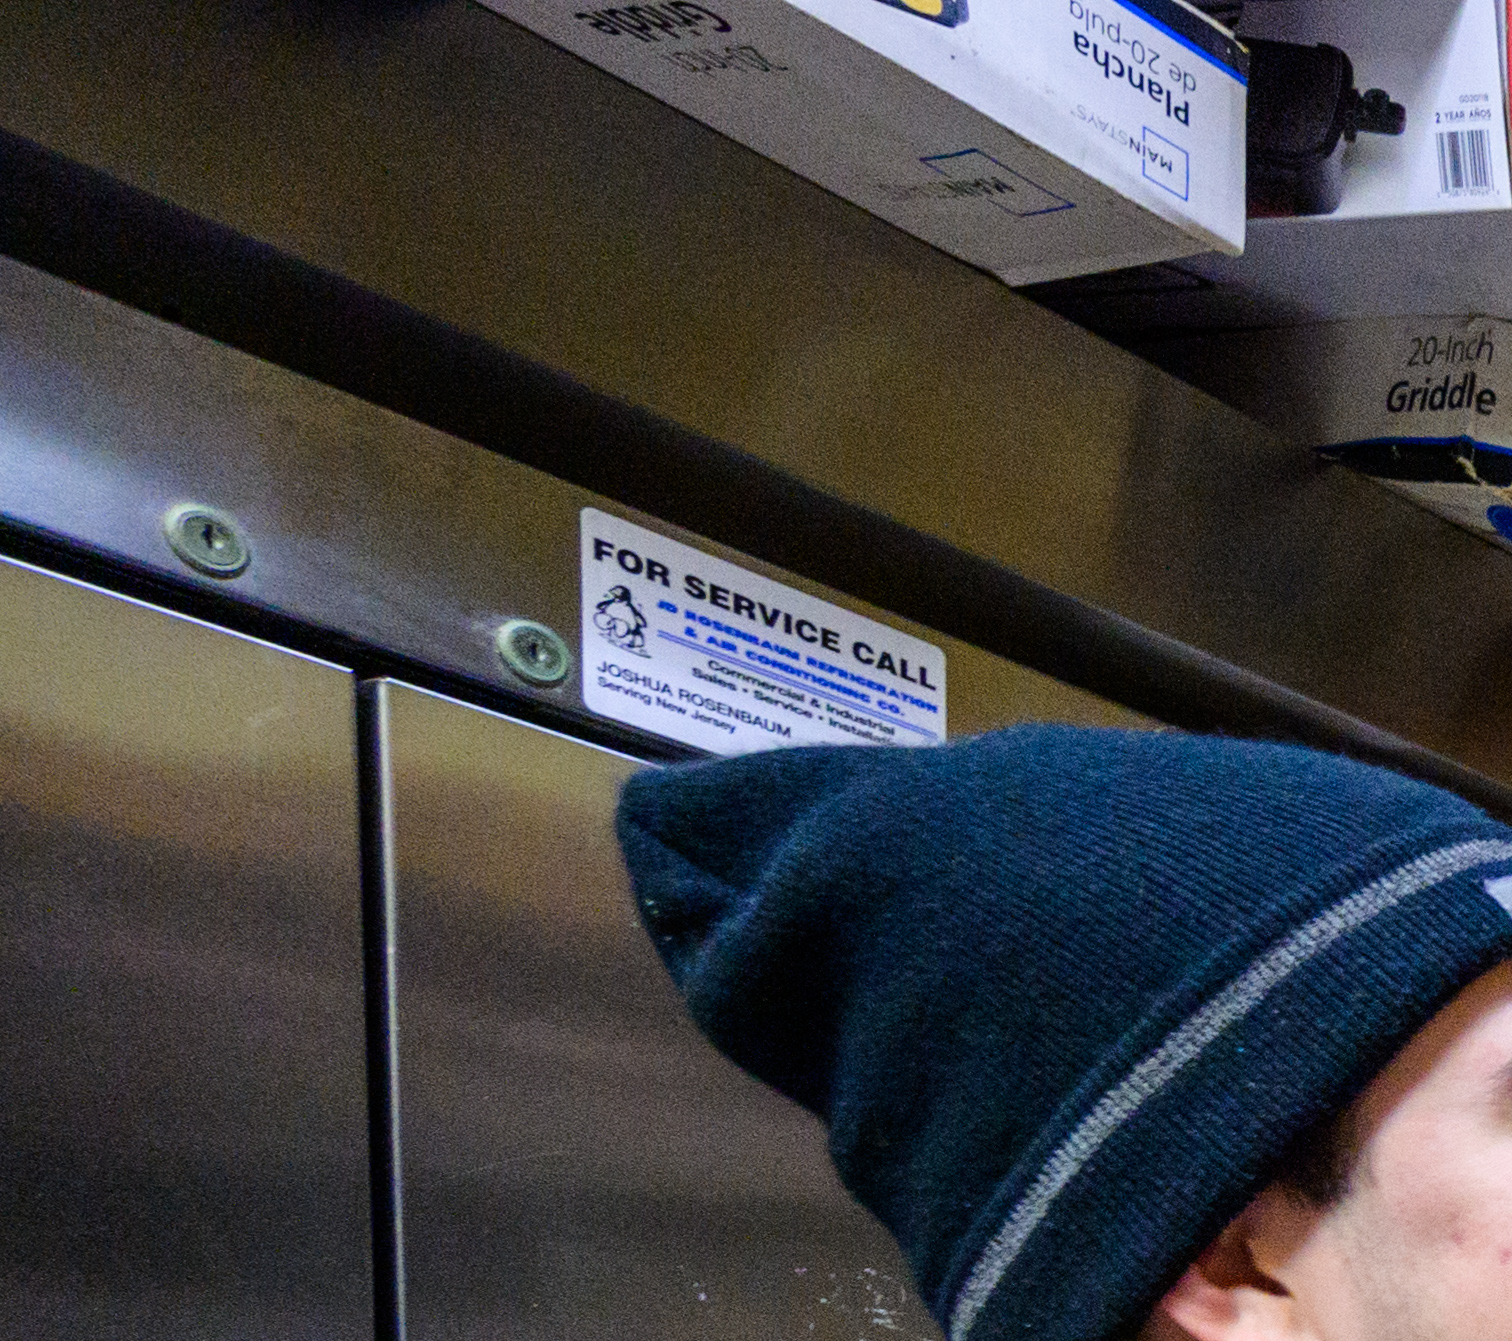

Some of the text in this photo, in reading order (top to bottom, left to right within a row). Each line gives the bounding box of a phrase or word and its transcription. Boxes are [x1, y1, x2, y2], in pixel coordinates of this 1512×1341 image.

[1073, 30, 1190, 127] Plancha
[1169, 61, 1197, 93] de
[1435, 108, 1492, 124] 2 YEAR AÑOS
[1407, 333, 1495, 368] 20-Inch
[1386, 371, 1498, 415] Griddle
[592, 537, 937, 691] FOR SERVICE CALL
[684, 625, 698, 639] &
[706, 635, 740, 655] AIR
[745, 649, 872, 706] CONDITIONING
[692, 666, 738, 693] Sales
[753, 689, 814, 720] Service
[806, 655, 939, 715] REFRIGERATION
[596, 661, 792, 738] JOSHUA ROSENBAUM
[597, 676, 737, 735] Serving New Jersey
[707, 659, 896, 737] Commercial & Industrial
